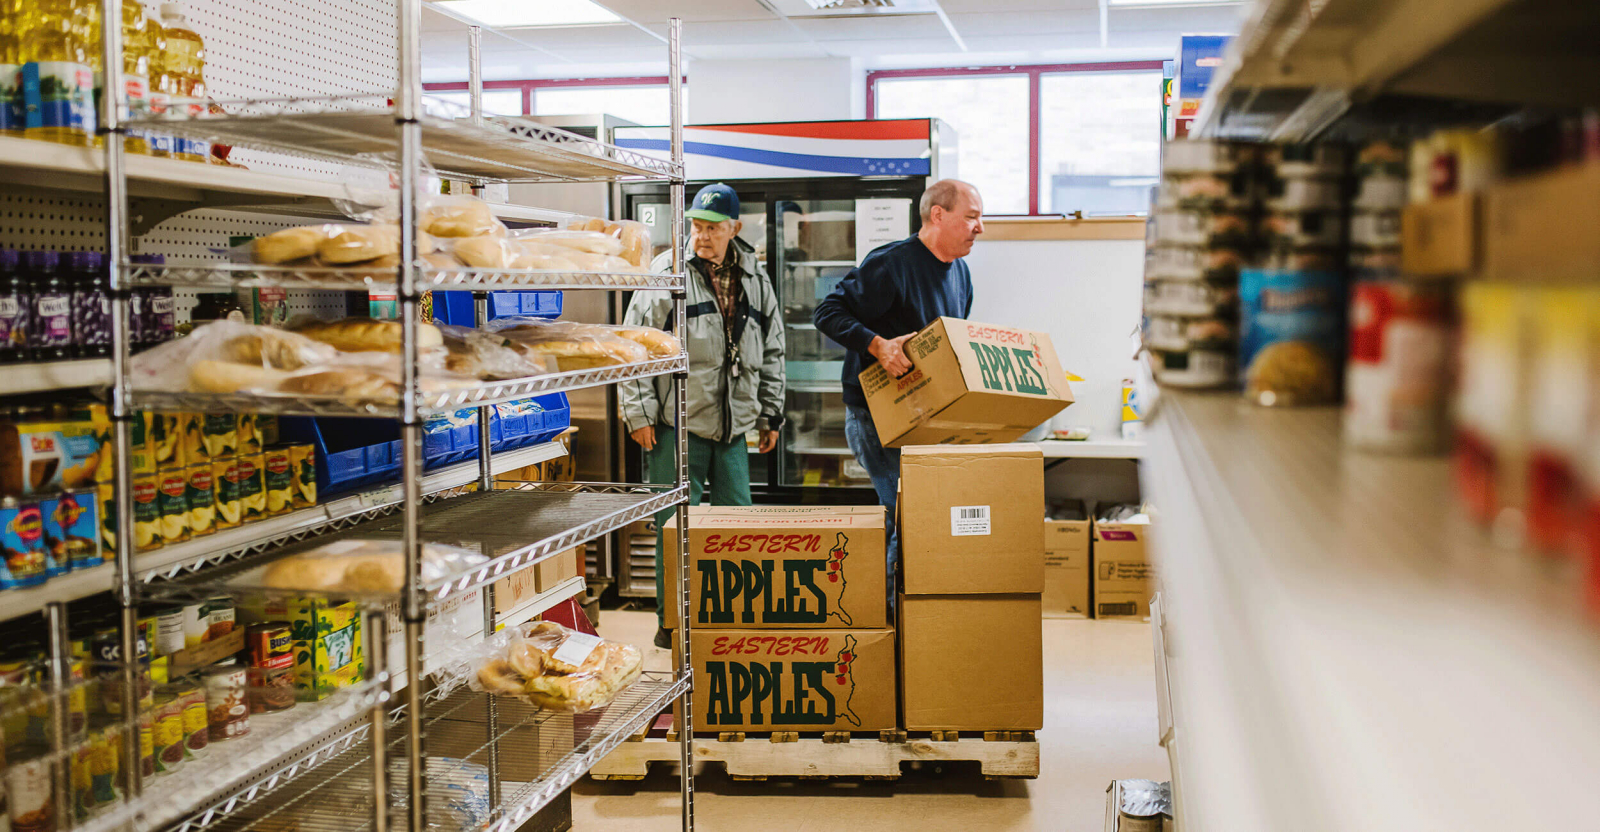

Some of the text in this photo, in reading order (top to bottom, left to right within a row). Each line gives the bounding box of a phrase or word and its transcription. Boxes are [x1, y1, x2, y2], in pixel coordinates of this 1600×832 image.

[701, 192, 721, 206] W
[645, 210, 653, 223] 2
[967, 325, 1025, 346] EASTERN
[969, 341, 1048, 395] APPLES
[897, 369, 923, 392] APPLES
[704, 534, 821, 553] EASTERN
[697, 559, 827, 623] APPLES
[711, 636, 829, 656] EASTERN
[706, 661, 836, 724] APPLES
